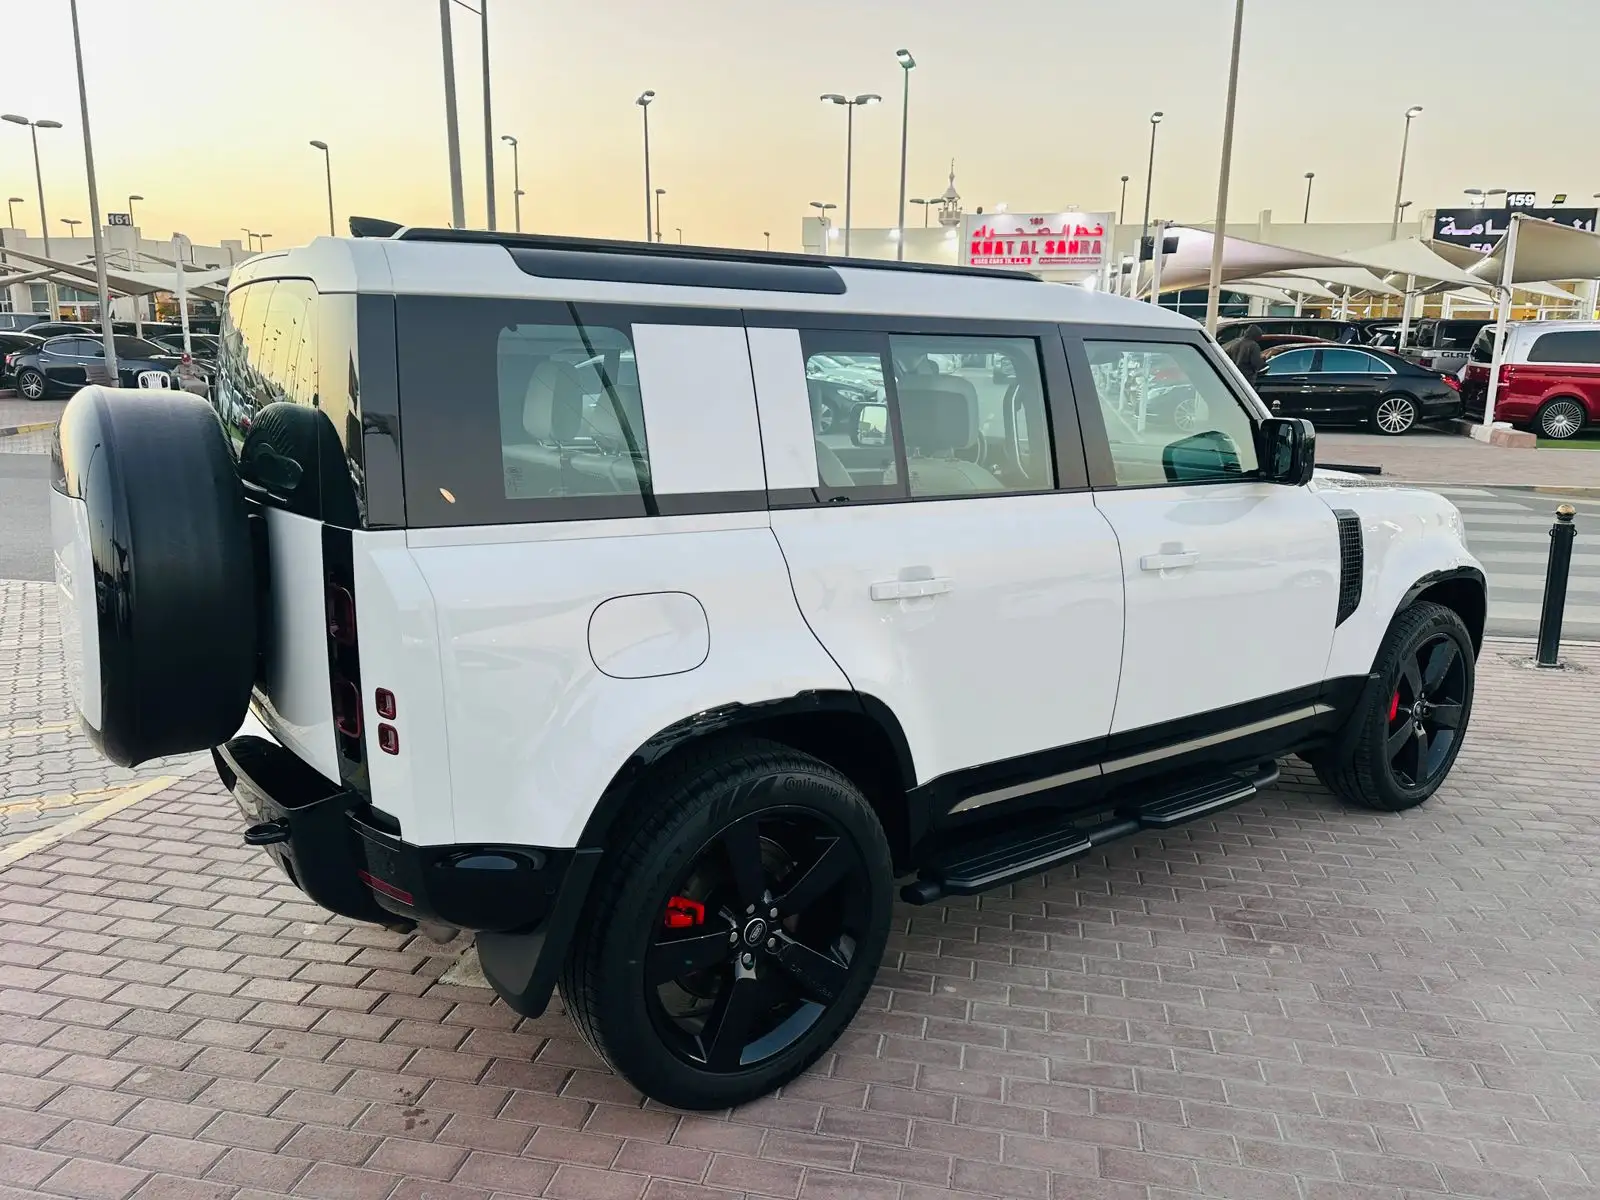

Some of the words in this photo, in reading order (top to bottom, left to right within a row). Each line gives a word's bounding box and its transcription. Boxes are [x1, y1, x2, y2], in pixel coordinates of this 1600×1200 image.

[1508, 194, 1535, 207] 159
[110, 215, 129, 225] 161
[1020, 240, 1039, 254] AL
